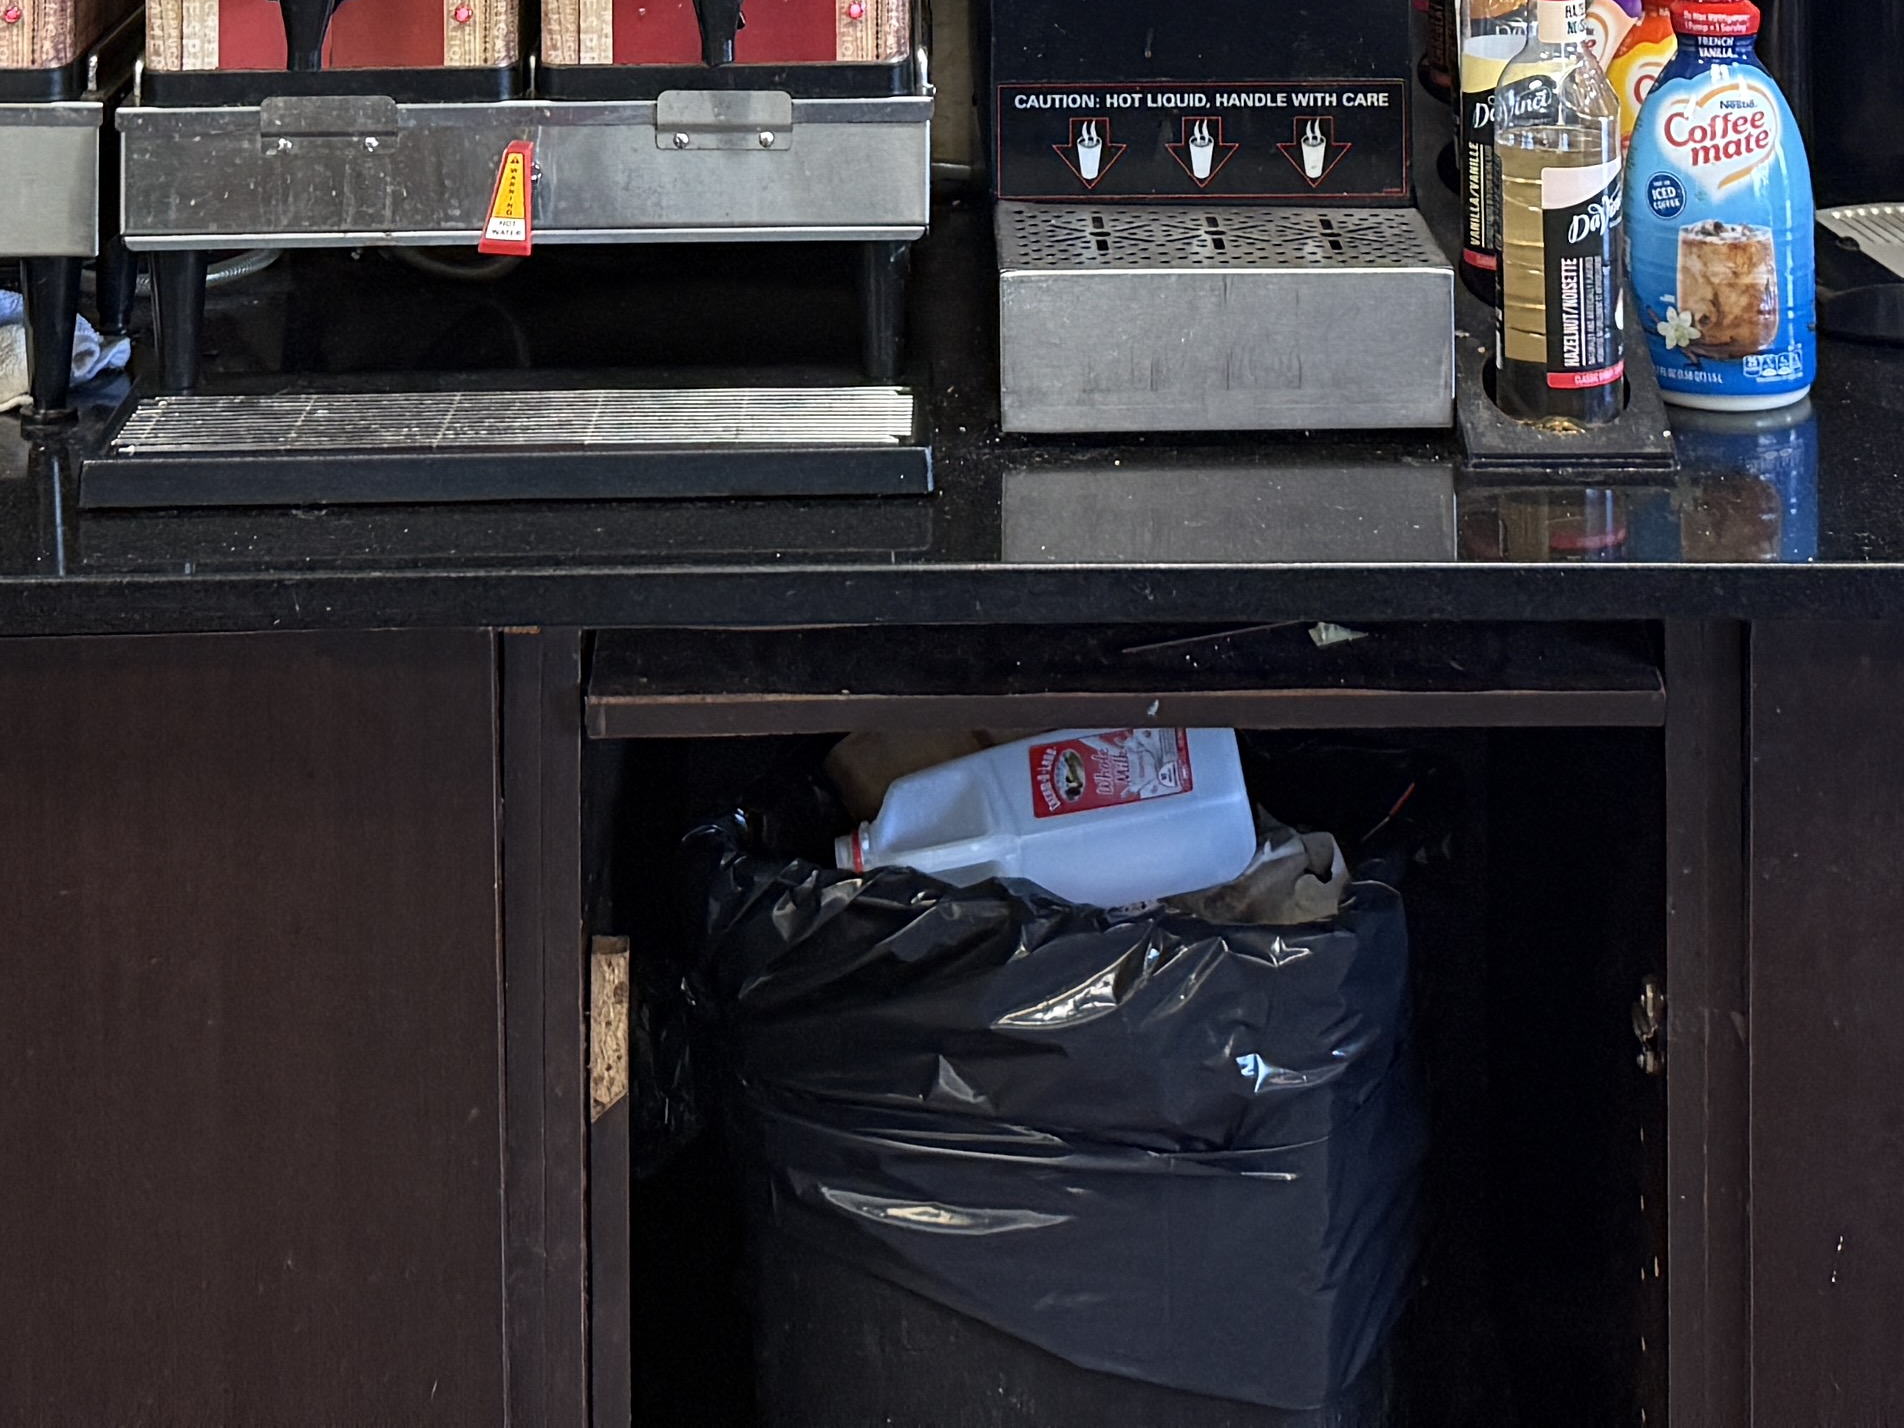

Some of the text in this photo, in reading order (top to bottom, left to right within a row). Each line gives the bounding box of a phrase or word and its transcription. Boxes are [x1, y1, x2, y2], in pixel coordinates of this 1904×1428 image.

[1697, 37, 1734, 46] FRENCH
[1699, 47, 1733, 58] VANILLA
[1014, 93, 1389, 110] CAUTION: HOT LIQUID, HANDLE WITH CARE
[1664, 110, 1765, 148] Coffee
[1691, 130, 1769, 166] mate
[506, 168, 518, 215] WARNING
[1469, 141, 1479, 247] VANILLA/VANILLE
[1651, 188, 1676, 200] ICED
[1653, 198, 1680, 210] COFFEE
[1561, 257, 1579, 368] HAZELNUT/NOISETTE
